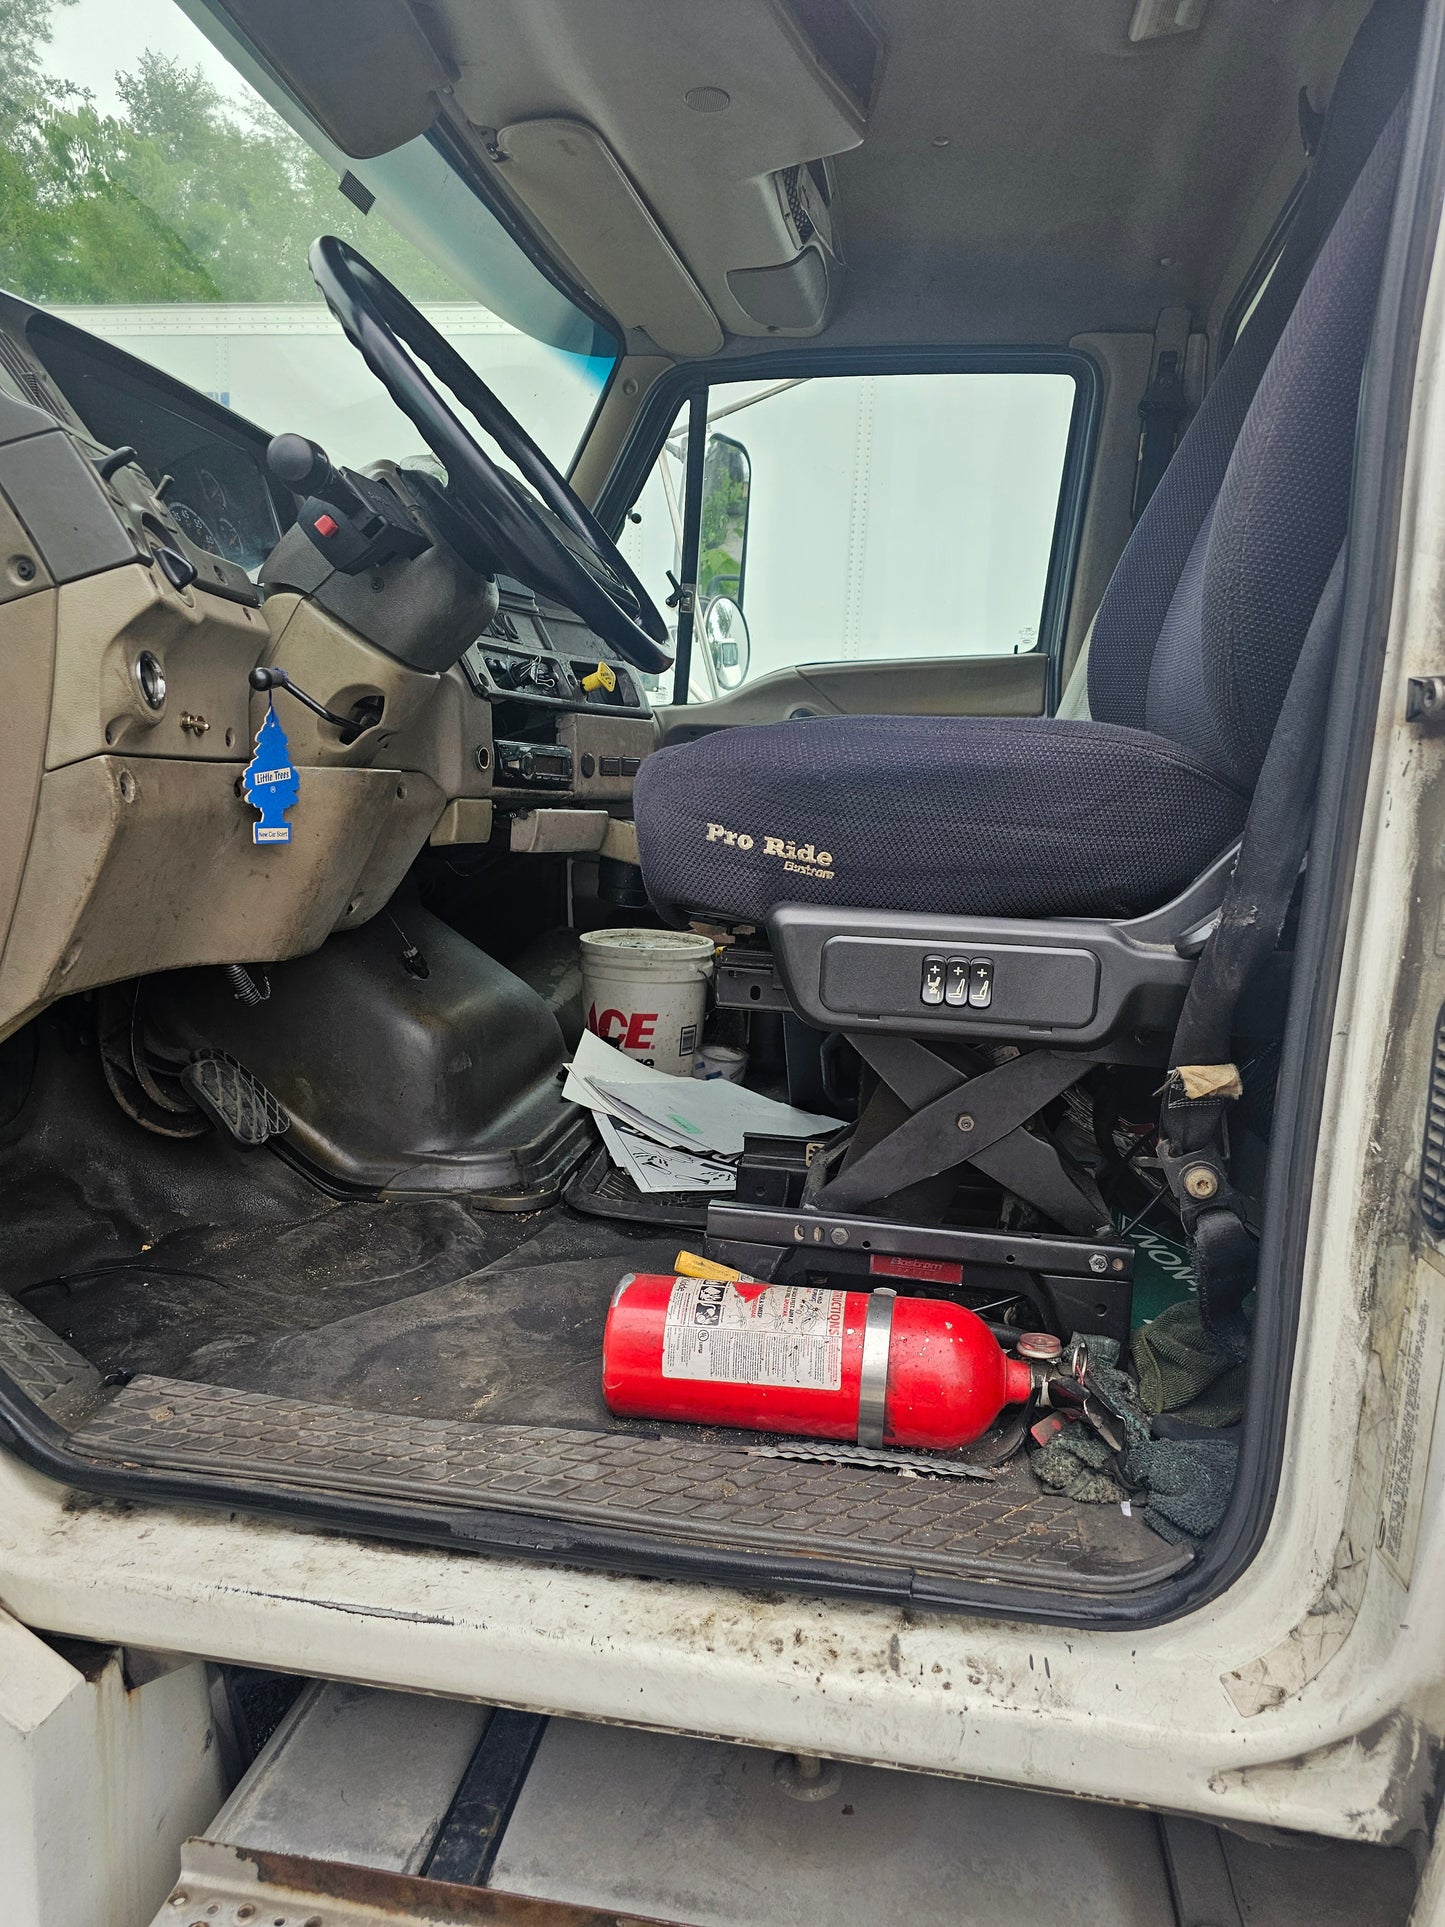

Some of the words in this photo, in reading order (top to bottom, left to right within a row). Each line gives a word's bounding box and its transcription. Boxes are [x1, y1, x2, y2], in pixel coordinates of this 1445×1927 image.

[256, 772, 273, 785] Little
[274, 770, 290, 781] Trees
[705, 822, 754, 851] Pro
[763, 835, 833, 867] Ride
